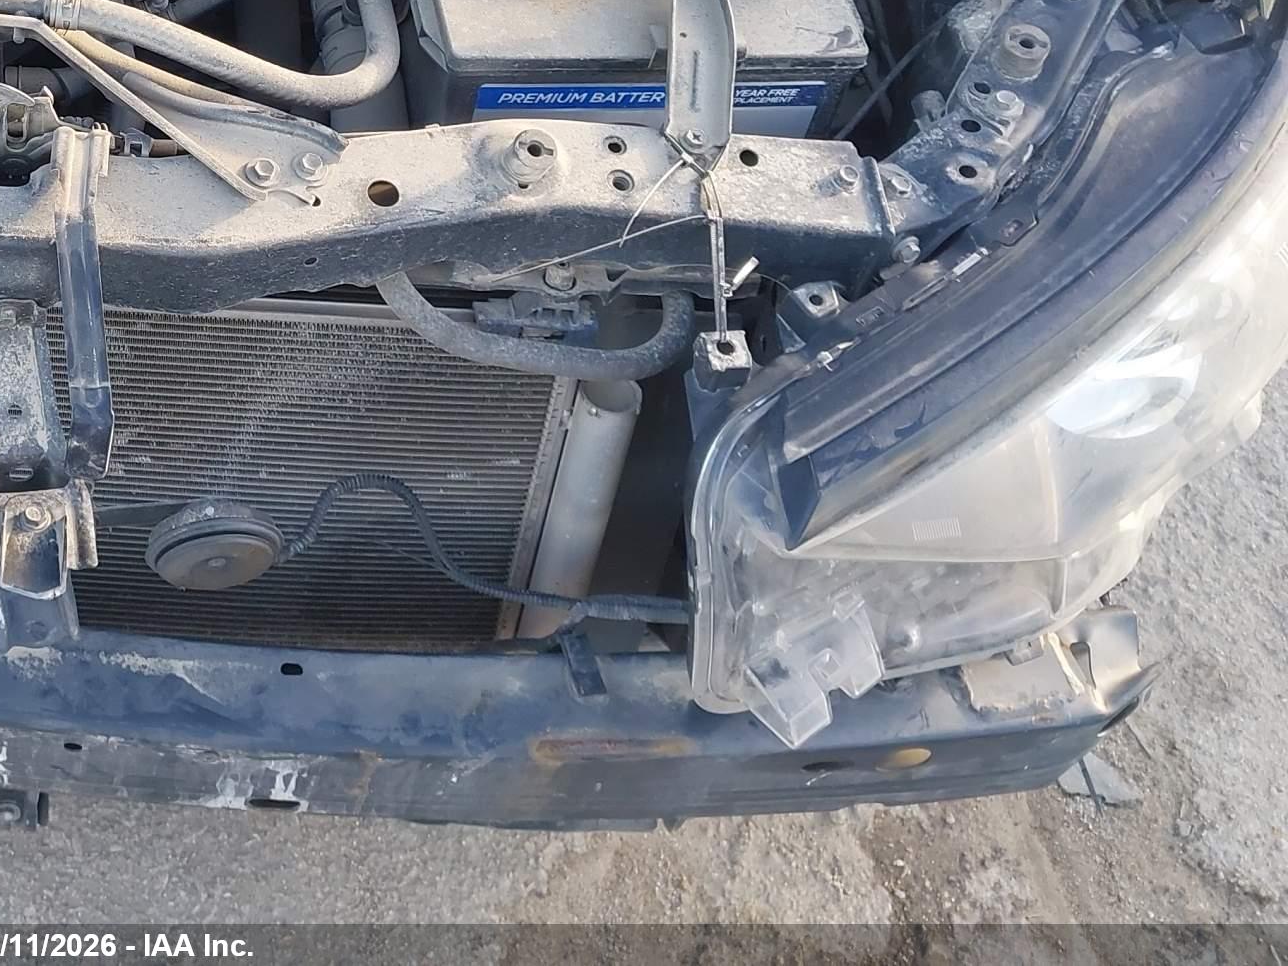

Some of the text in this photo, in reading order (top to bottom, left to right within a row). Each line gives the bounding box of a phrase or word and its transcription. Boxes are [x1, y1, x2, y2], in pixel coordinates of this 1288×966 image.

[735, 88, 800, 97] YEAR FREE
[497, 92, 665, 104] PREMIUM BATTER
[734, 96, 795, 104] PLACEMENT
